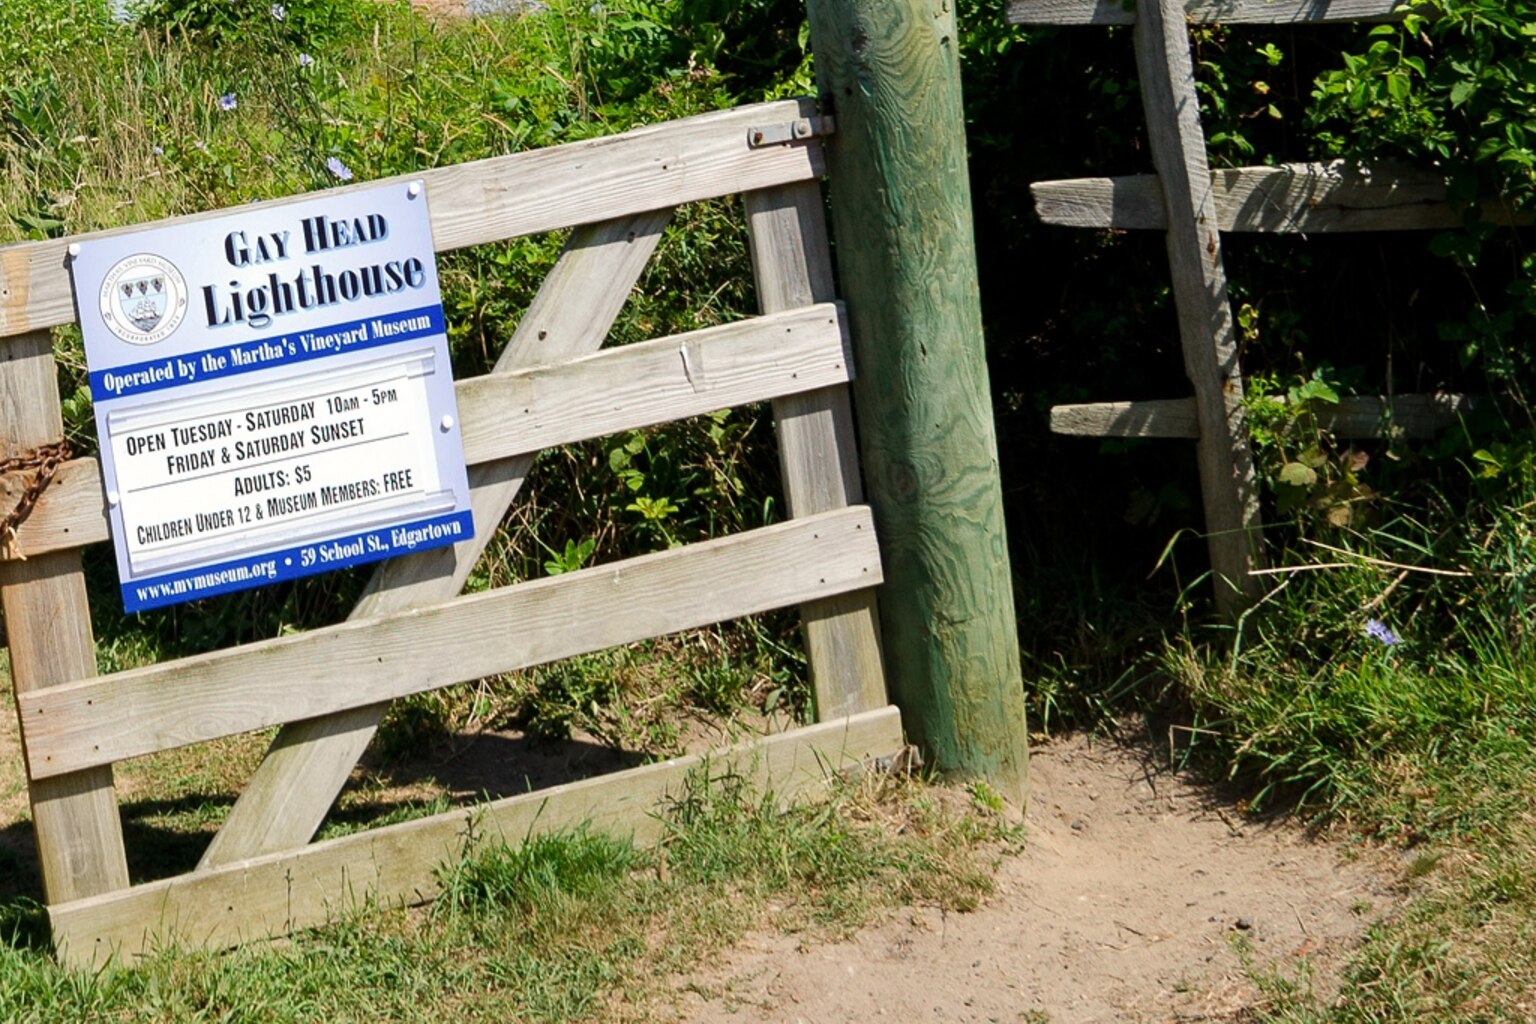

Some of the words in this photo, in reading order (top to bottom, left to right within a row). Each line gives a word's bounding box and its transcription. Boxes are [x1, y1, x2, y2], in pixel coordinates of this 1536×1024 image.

[224, 230, 291, 268] GAY
[300, 213, 389, 256] HEAD
[200, 257, 426, 329] Lighthouse
[103, 366, 175, 392] Operated
[177, 362, 196, 381] by
[202, 353, 227, 372] the
[229, 340, 296, 367] Martha's
[300, 323, 368, 352] Vineyard
[371, 315, 431, 335] Museum
[126, 433, 166, 456] OPEN
[171, 419, 232, 447] TUESDAY
[245, 402, 315, 431] SATURDAY
[326, 396, 360, 415] 10AM
[372, 388, 398, 405] 5PM
[166, 449, 215, 475] FRIDAY
[221, 448, 231, 464] &
[235, 431, 306, 461] SATURDAY
[311, 418, 365, 445] SUNSET
[137, 519, 193, 545] CHILDREN
[195, 509, 234, 531] UNDER
[238, 506, 252, 523] 12
[255, 504, 264, 521] &
[266, 491, 318, 517] MUSEUM
[320, 479, 381, 506] MEMBERS:
[383, 468, 414, 493] FREE
[234, 471, 291, 497] ADULTS:
[295, 464, 312, 484] $5
[136, 559, 276, 602] www.mvmuseum.org
[300, 549, 317, 568] 59
[320, 538, 365, 563] School
[367, 534, 390, 553] St.,
[392, 519, 462, 549] Edgartown
